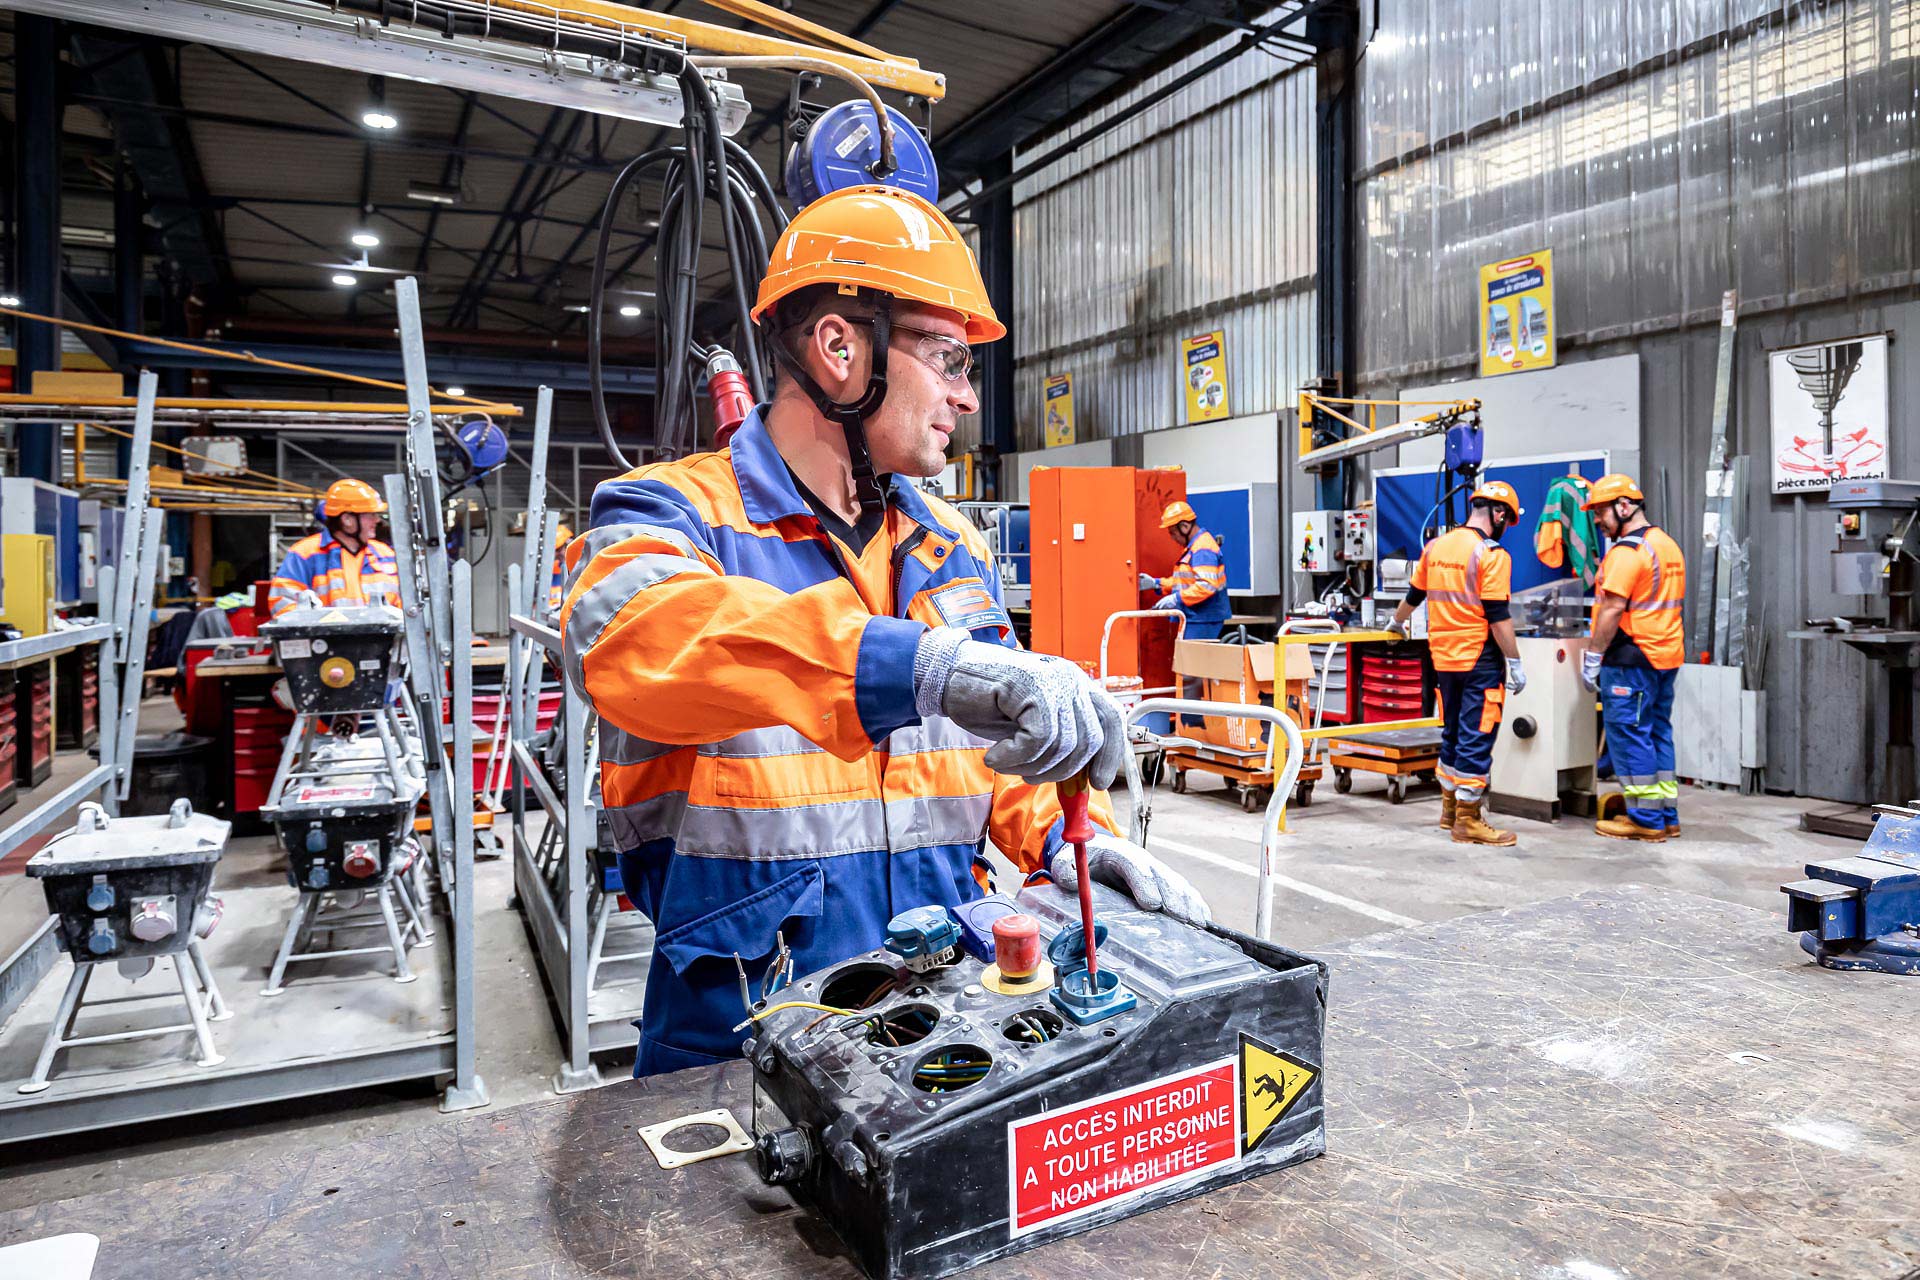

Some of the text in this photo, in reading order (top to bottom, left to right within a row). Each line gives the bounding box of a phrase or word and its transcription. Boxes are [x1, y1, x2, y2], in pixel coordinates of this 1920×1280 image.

[1777, 477, 1806, 490] pièce
[1808, 477, 1829, 487] non
[1023, 1104, 1231, 1190] A TOUTE PERSONNE
[1043, 1080, 1213, 1152] ACCÈS INTERDIT
[1050, 1141, 1208, 1212] NON HABILITÉE
